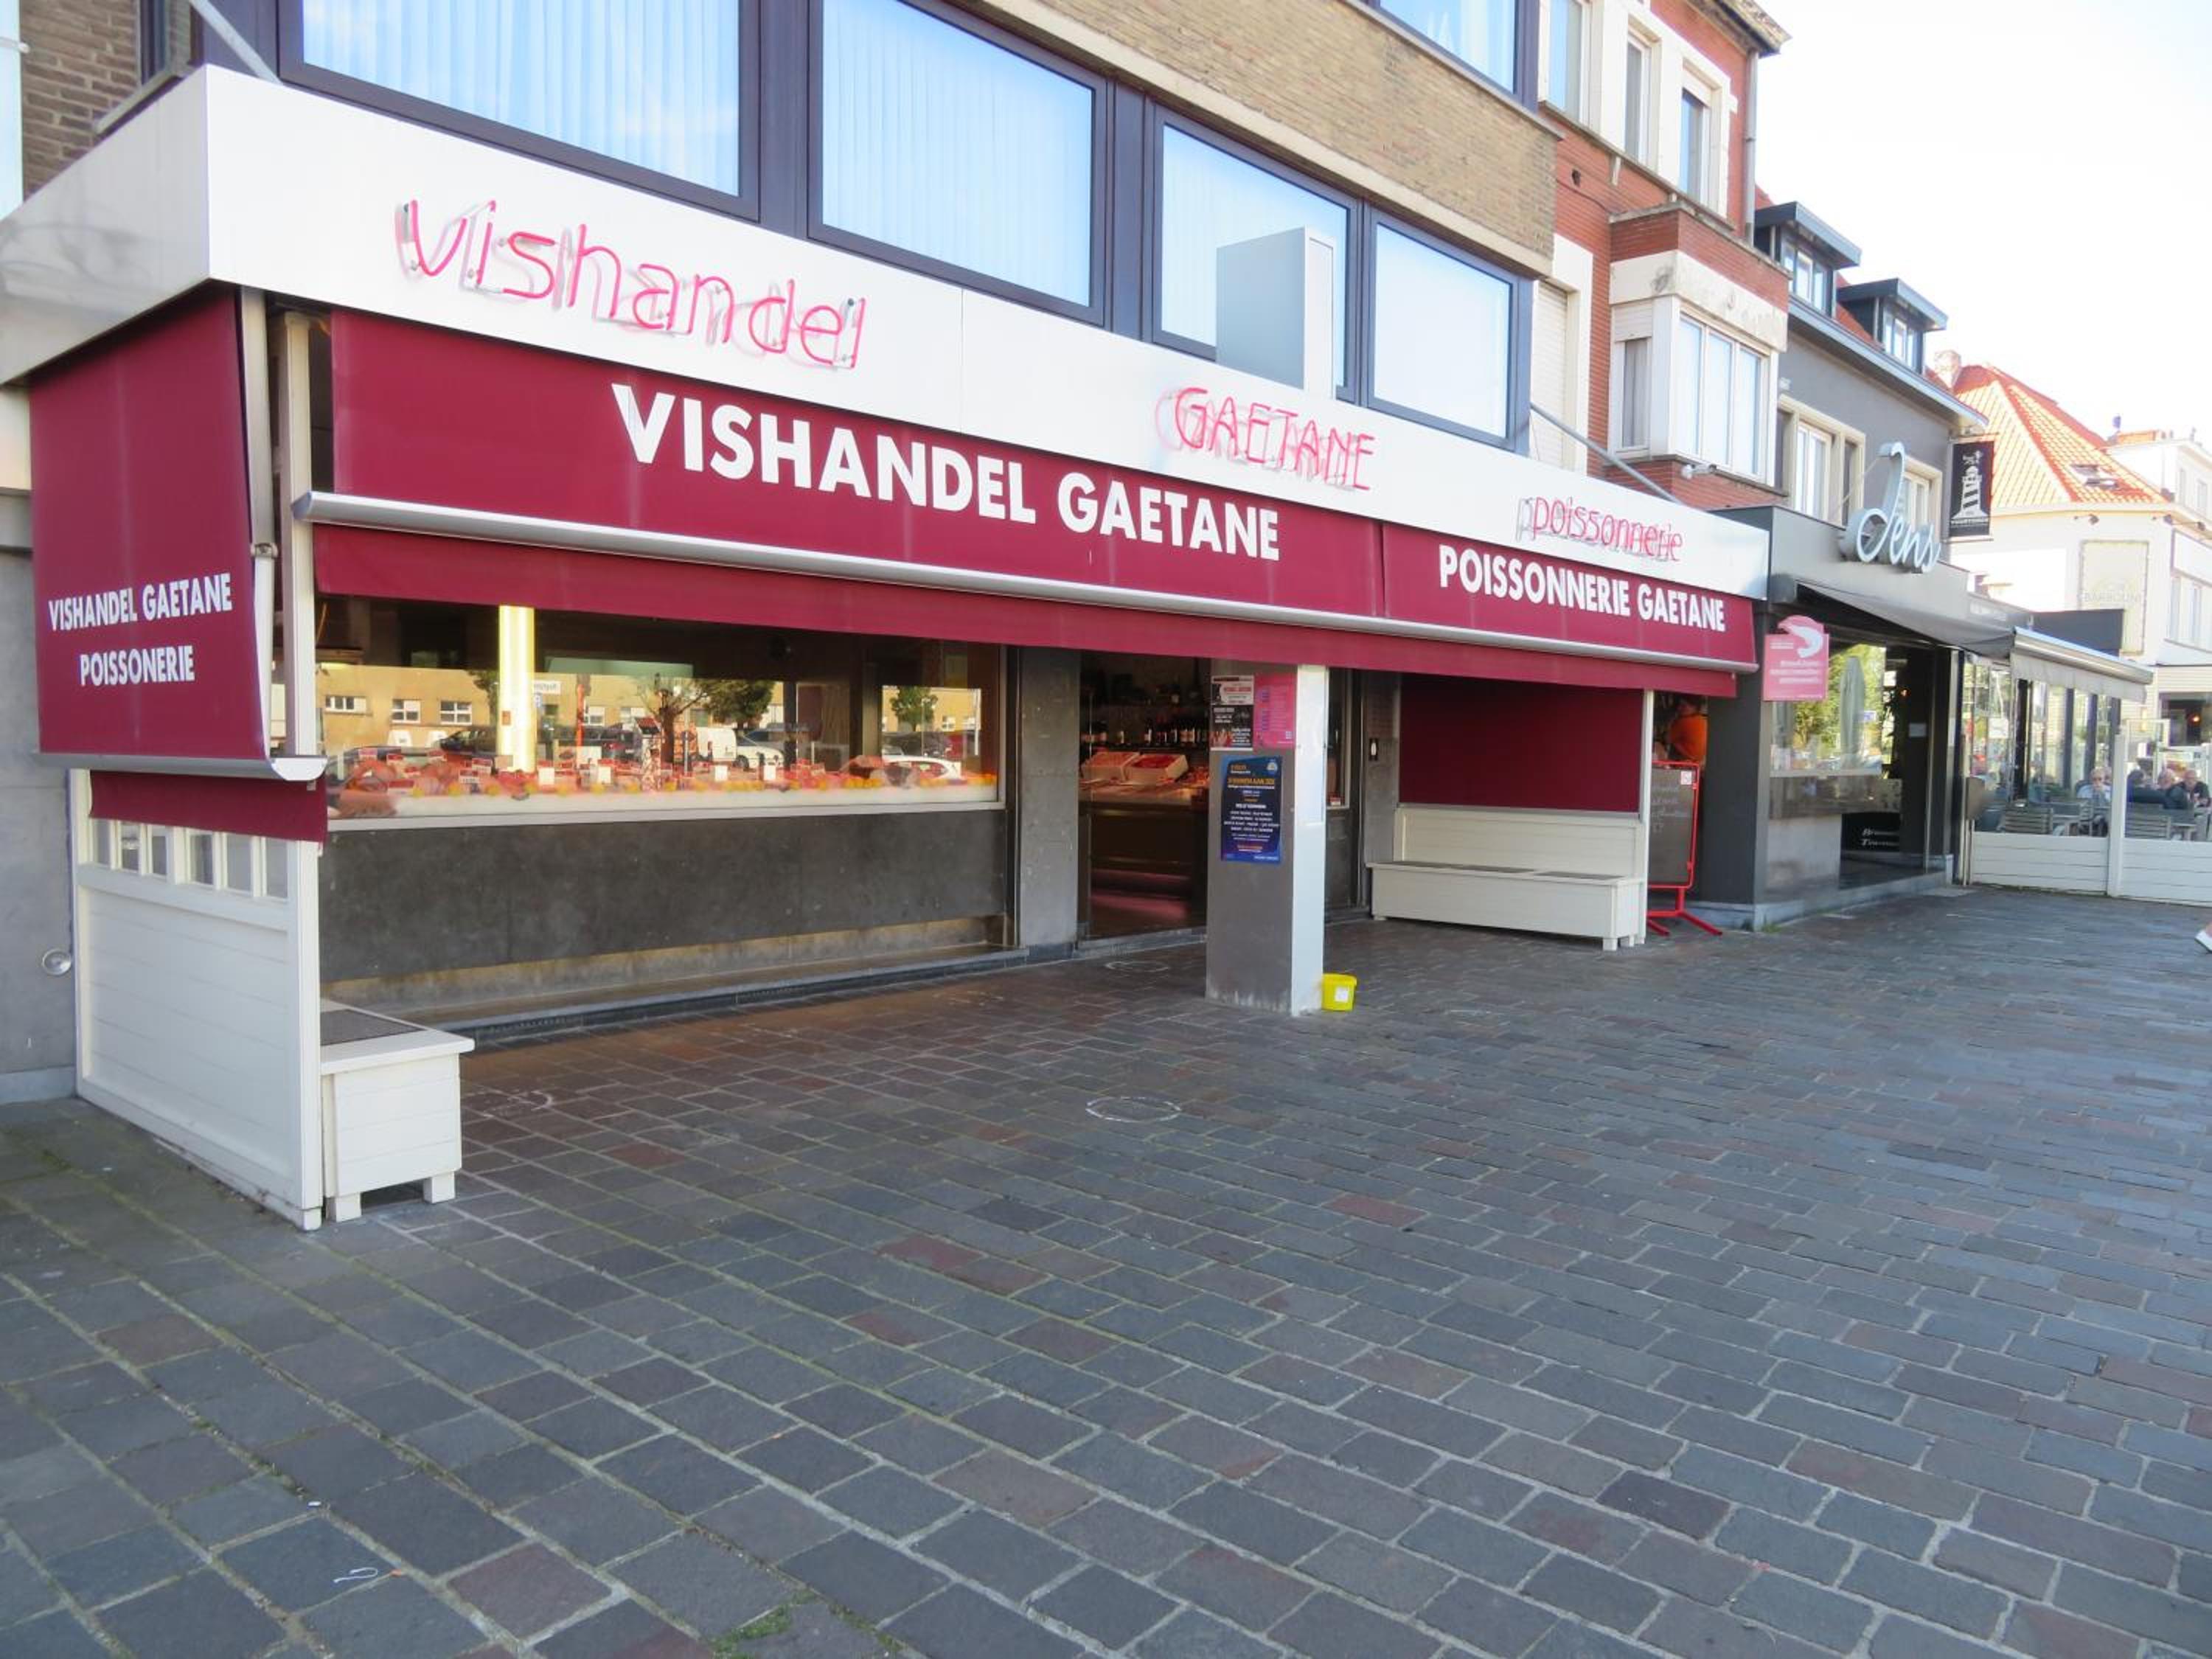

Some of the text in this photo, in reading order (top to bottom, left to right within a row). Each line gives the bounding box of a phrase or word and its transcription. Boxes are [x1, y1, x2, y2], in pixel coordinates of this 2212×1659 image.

[611, 383, 1281, 562] VISHANDEL GAETANE
[1174, 386, 1374, 490] GAETANE
[48, 572, 233, 631] VISHANDEL GAETANE
[1439, 544, 1726, 633] POISSONNERIE GAETANE
[80, 644, 195, 686] POISSONERIE
